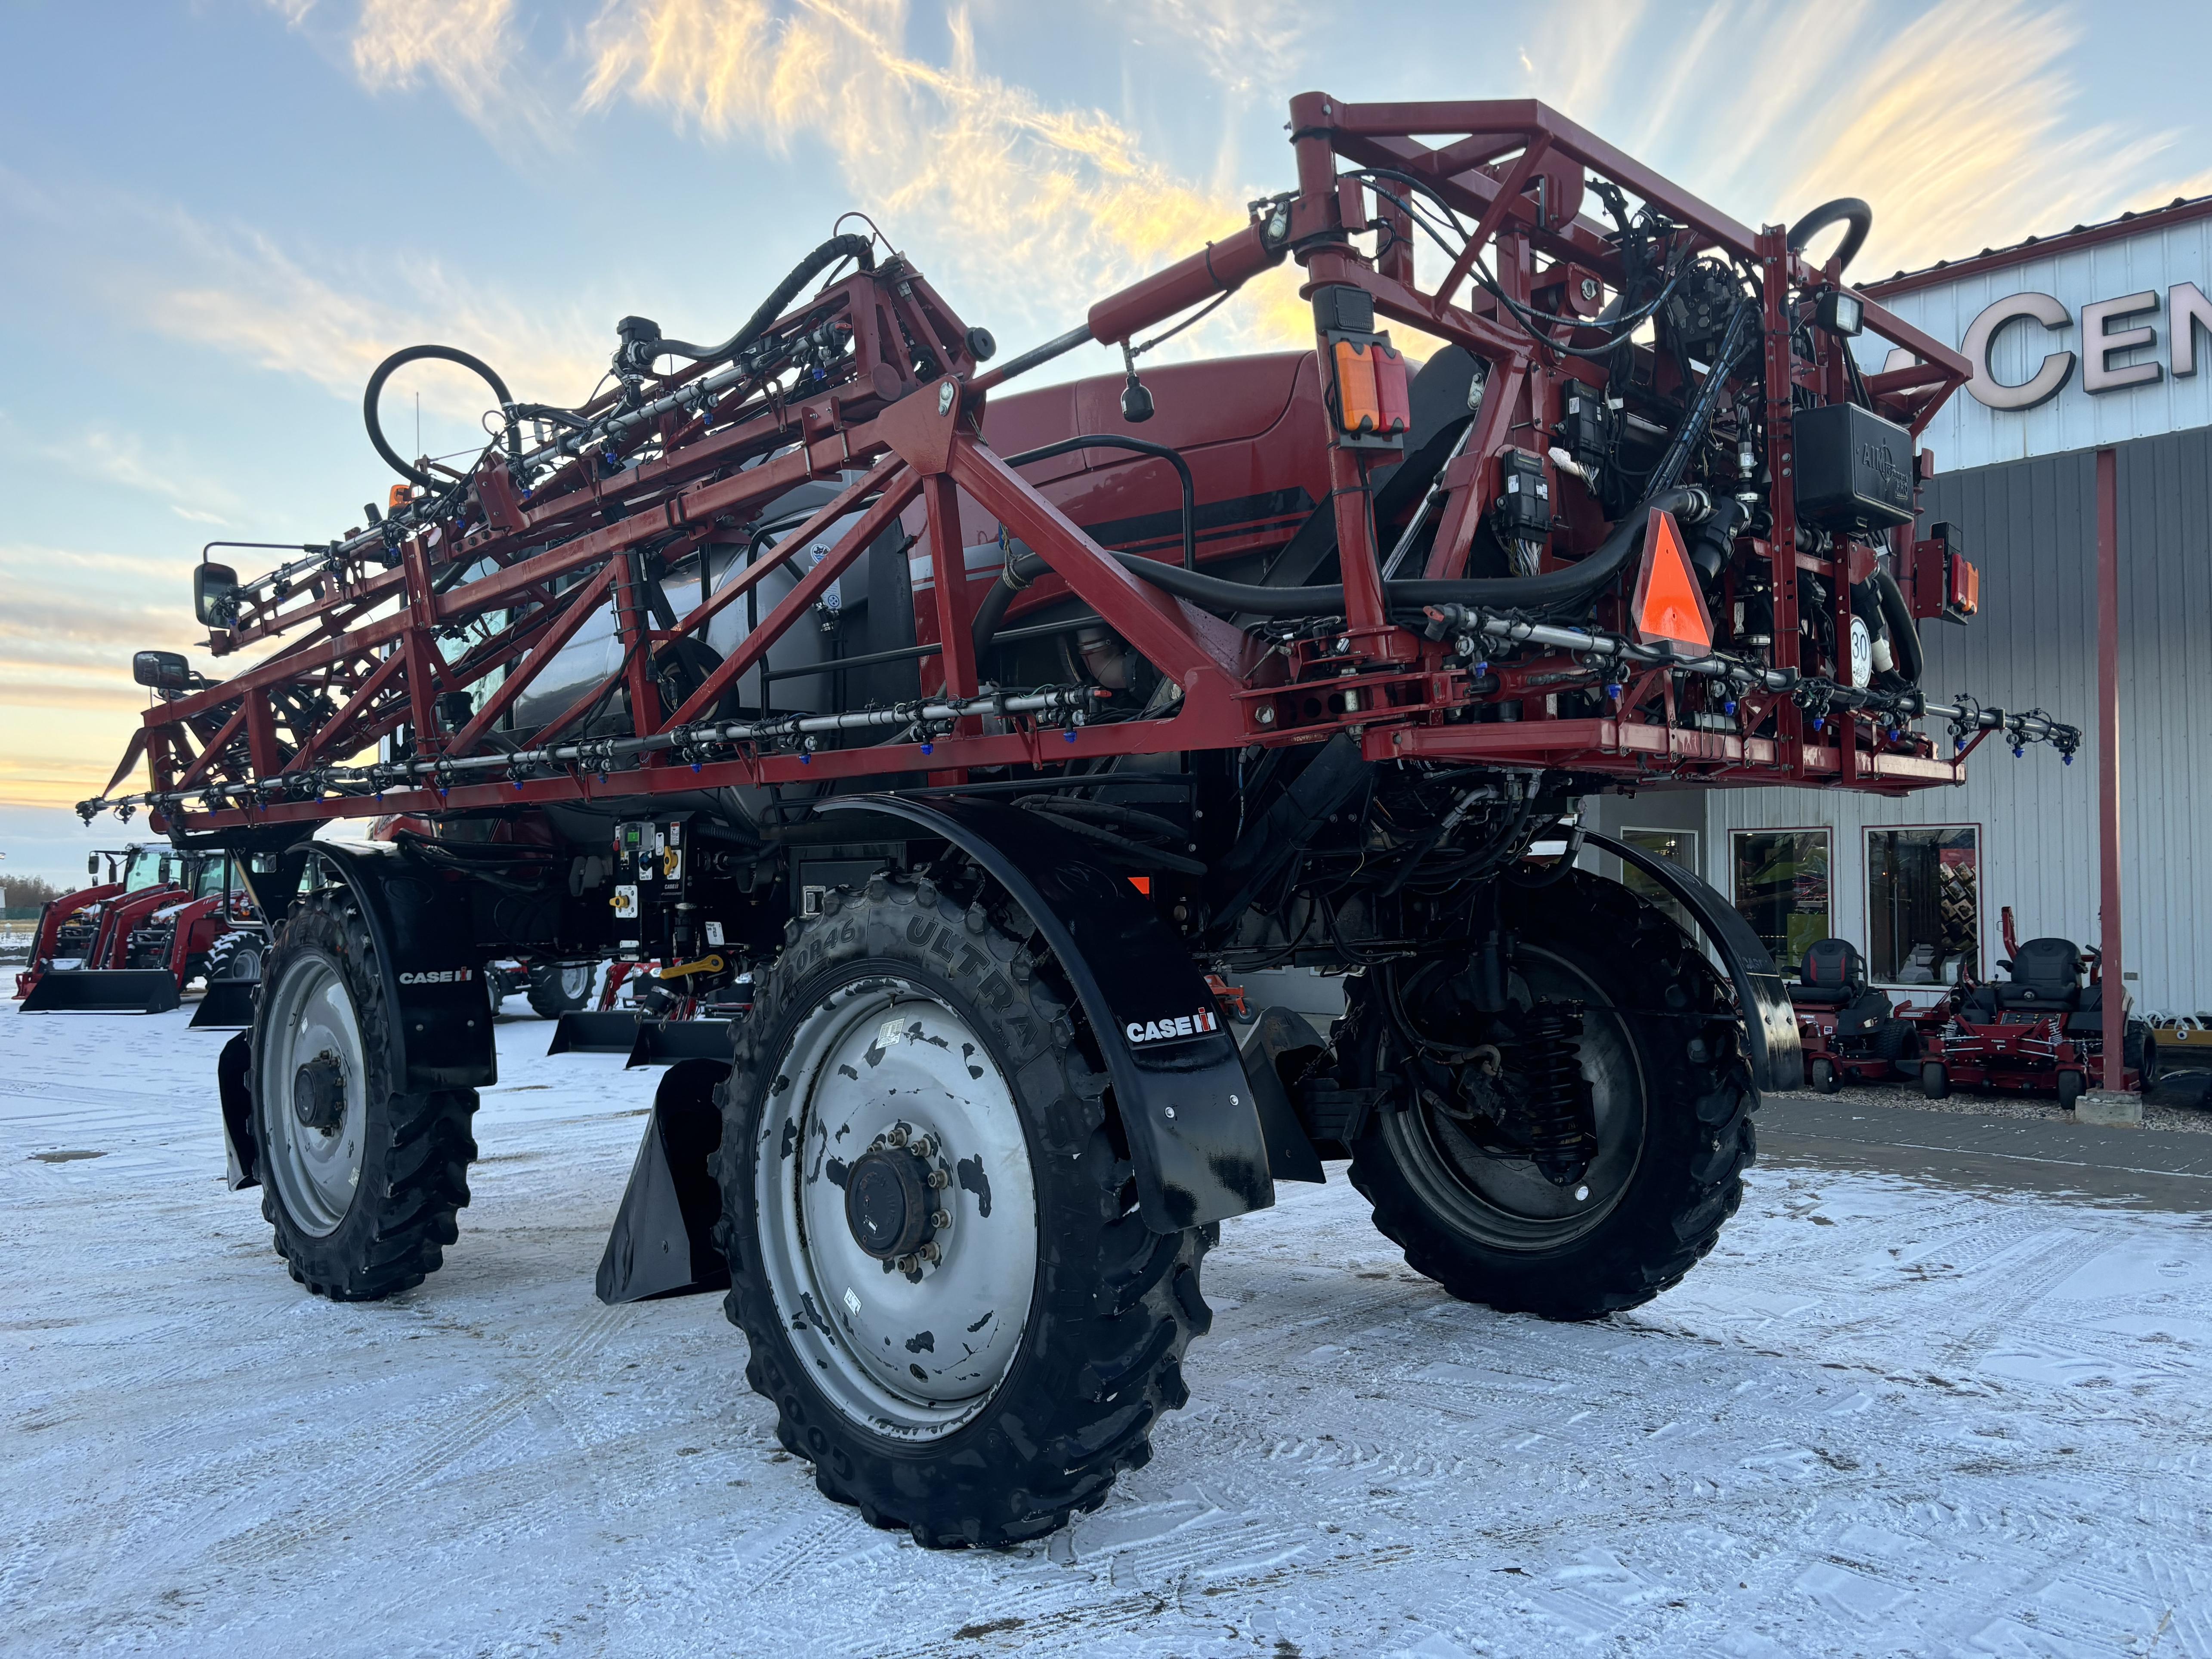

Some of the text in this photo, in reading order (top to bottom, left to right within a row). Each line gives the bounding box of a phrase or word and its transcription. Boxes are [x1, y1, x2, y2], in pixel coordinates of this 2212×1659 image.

[1852, 631, 1867, 662] 30
[399, 966, 472, 984] CASE IH
[906, 914, 1038, 1055] ULTRA
[1127, 1007, 1217, 1043] CASE IH
